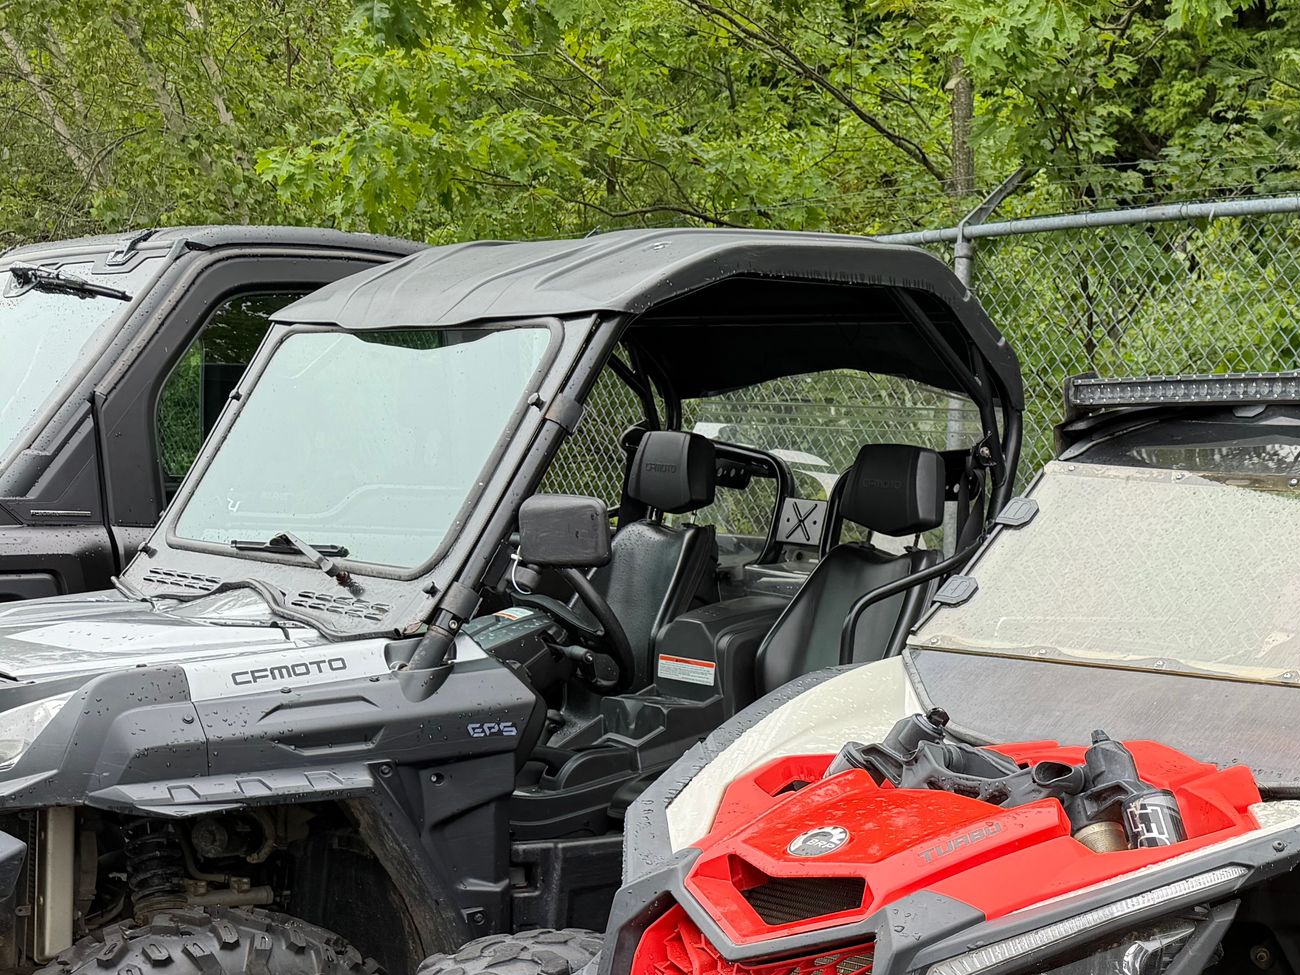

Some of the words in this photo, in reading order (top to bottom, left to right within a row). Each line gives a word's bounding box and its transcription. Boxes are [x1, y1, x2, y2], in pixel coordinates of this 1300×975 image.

[231, 657, 347, 685] CFMOTO
[467, 722, 517, 737] EPS
[806, 839, 835, 849] BRP
[919, 822, 1002, 862] TURBO
